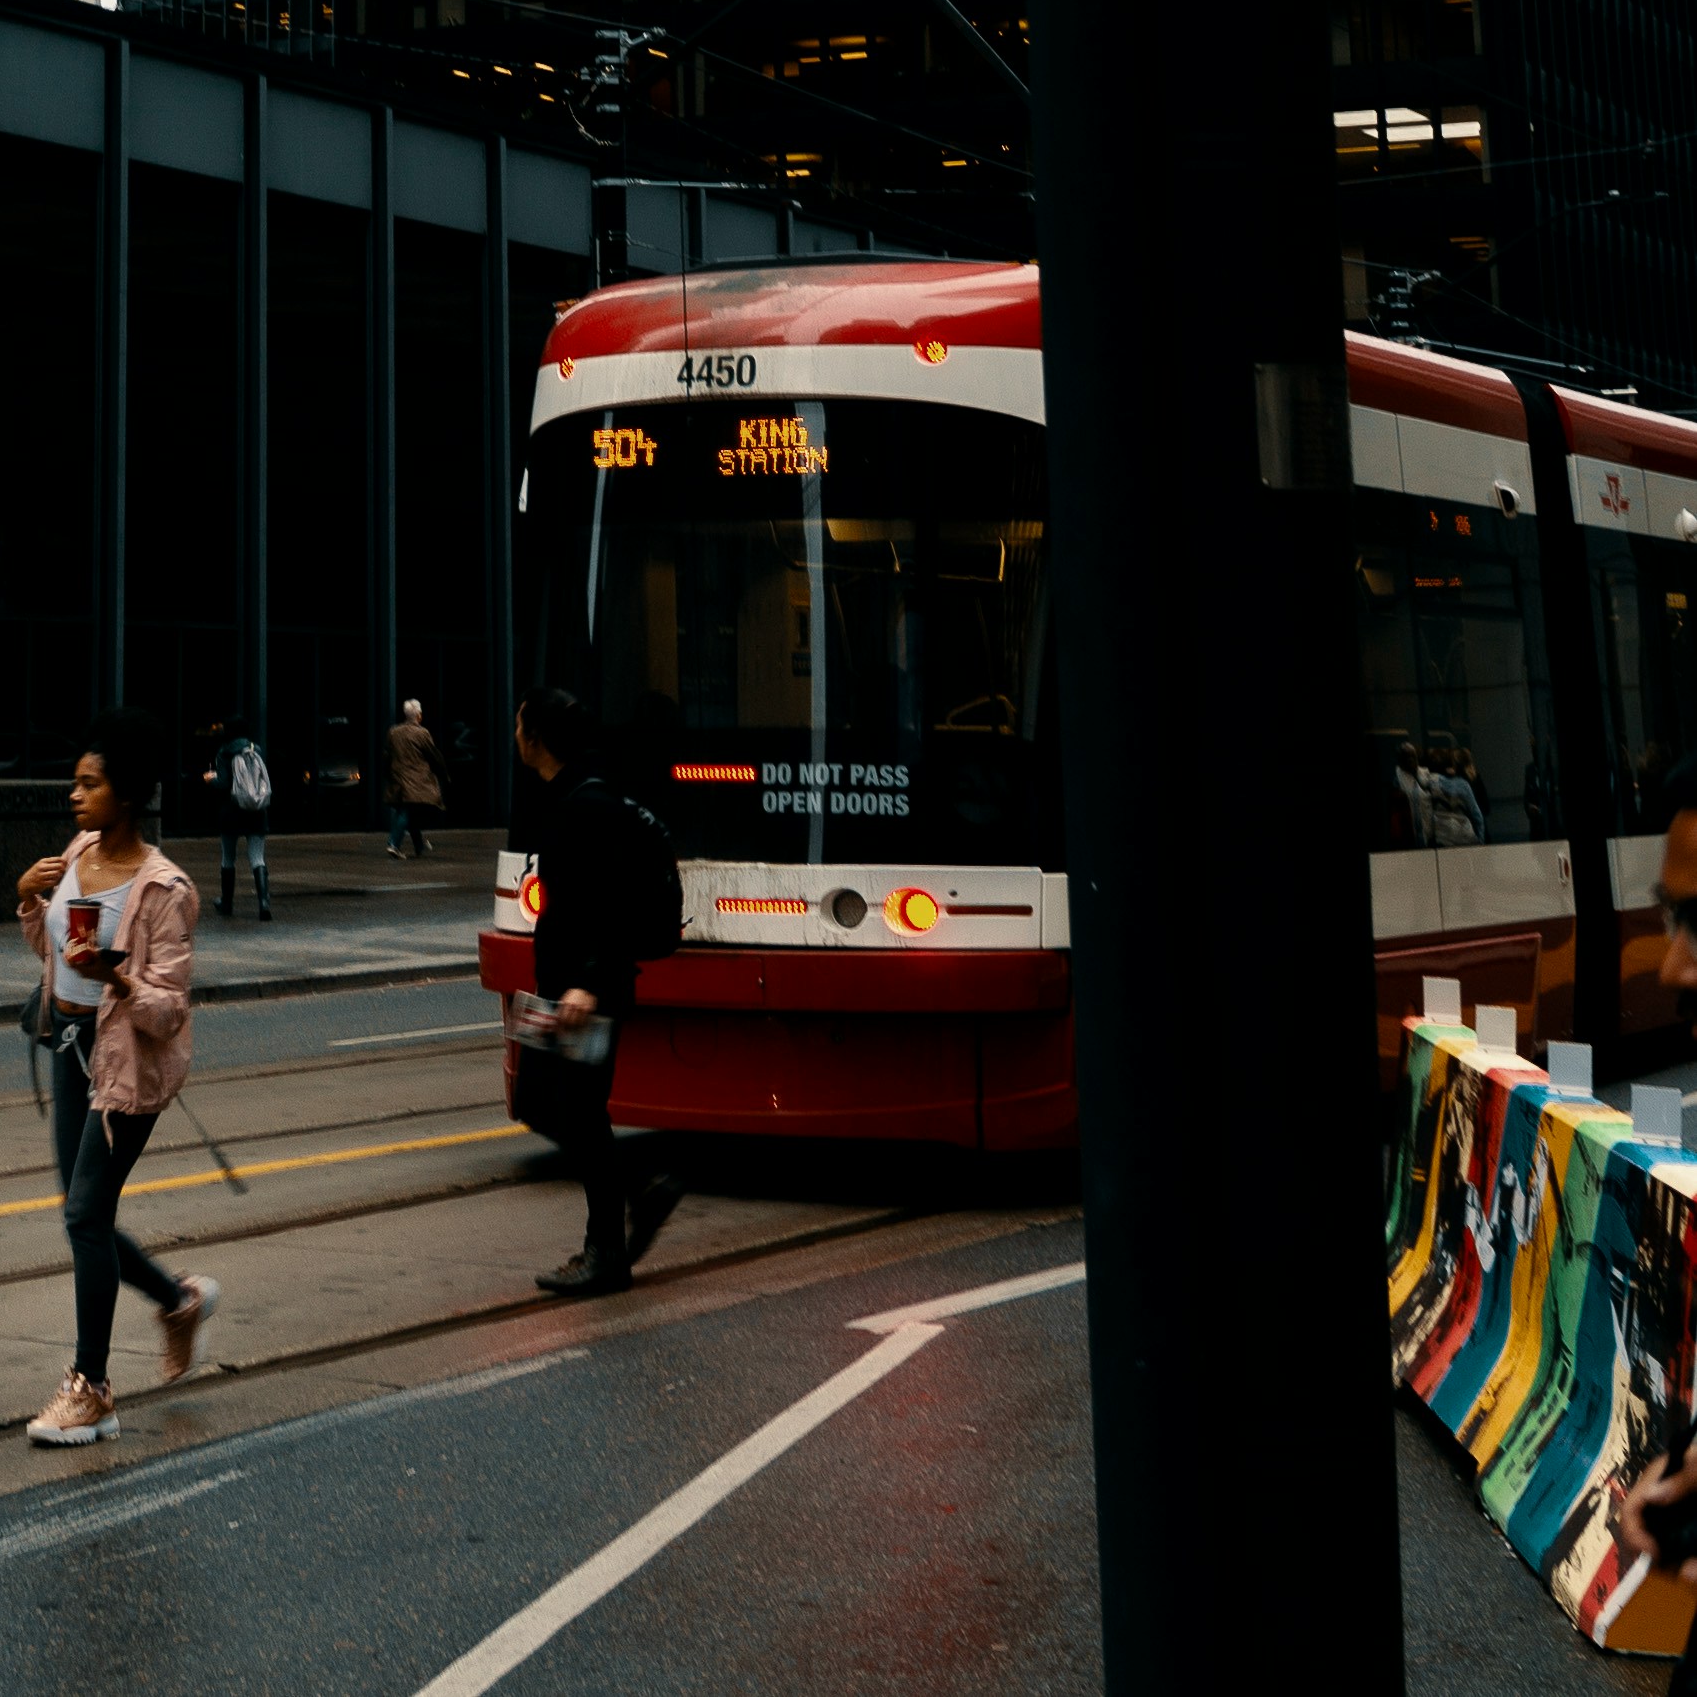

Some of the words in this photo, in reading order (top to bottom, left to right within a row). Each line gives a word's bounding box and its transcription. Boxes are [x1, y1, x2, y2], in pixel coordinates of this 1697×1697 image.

[677, 354, 757, 388] 4450
[740, 417, 808, 447] KING
[594, 429, 657, 468] 504
[718, 447, 829, 476] STATION
[762, 762, 792, 785] DO
[799, 762, 843, 786] NOT
[850, 763, 910, 788] PASS
[762, 791, 822, 814] OPEN
[830, 792, 910, 816] DOORS
